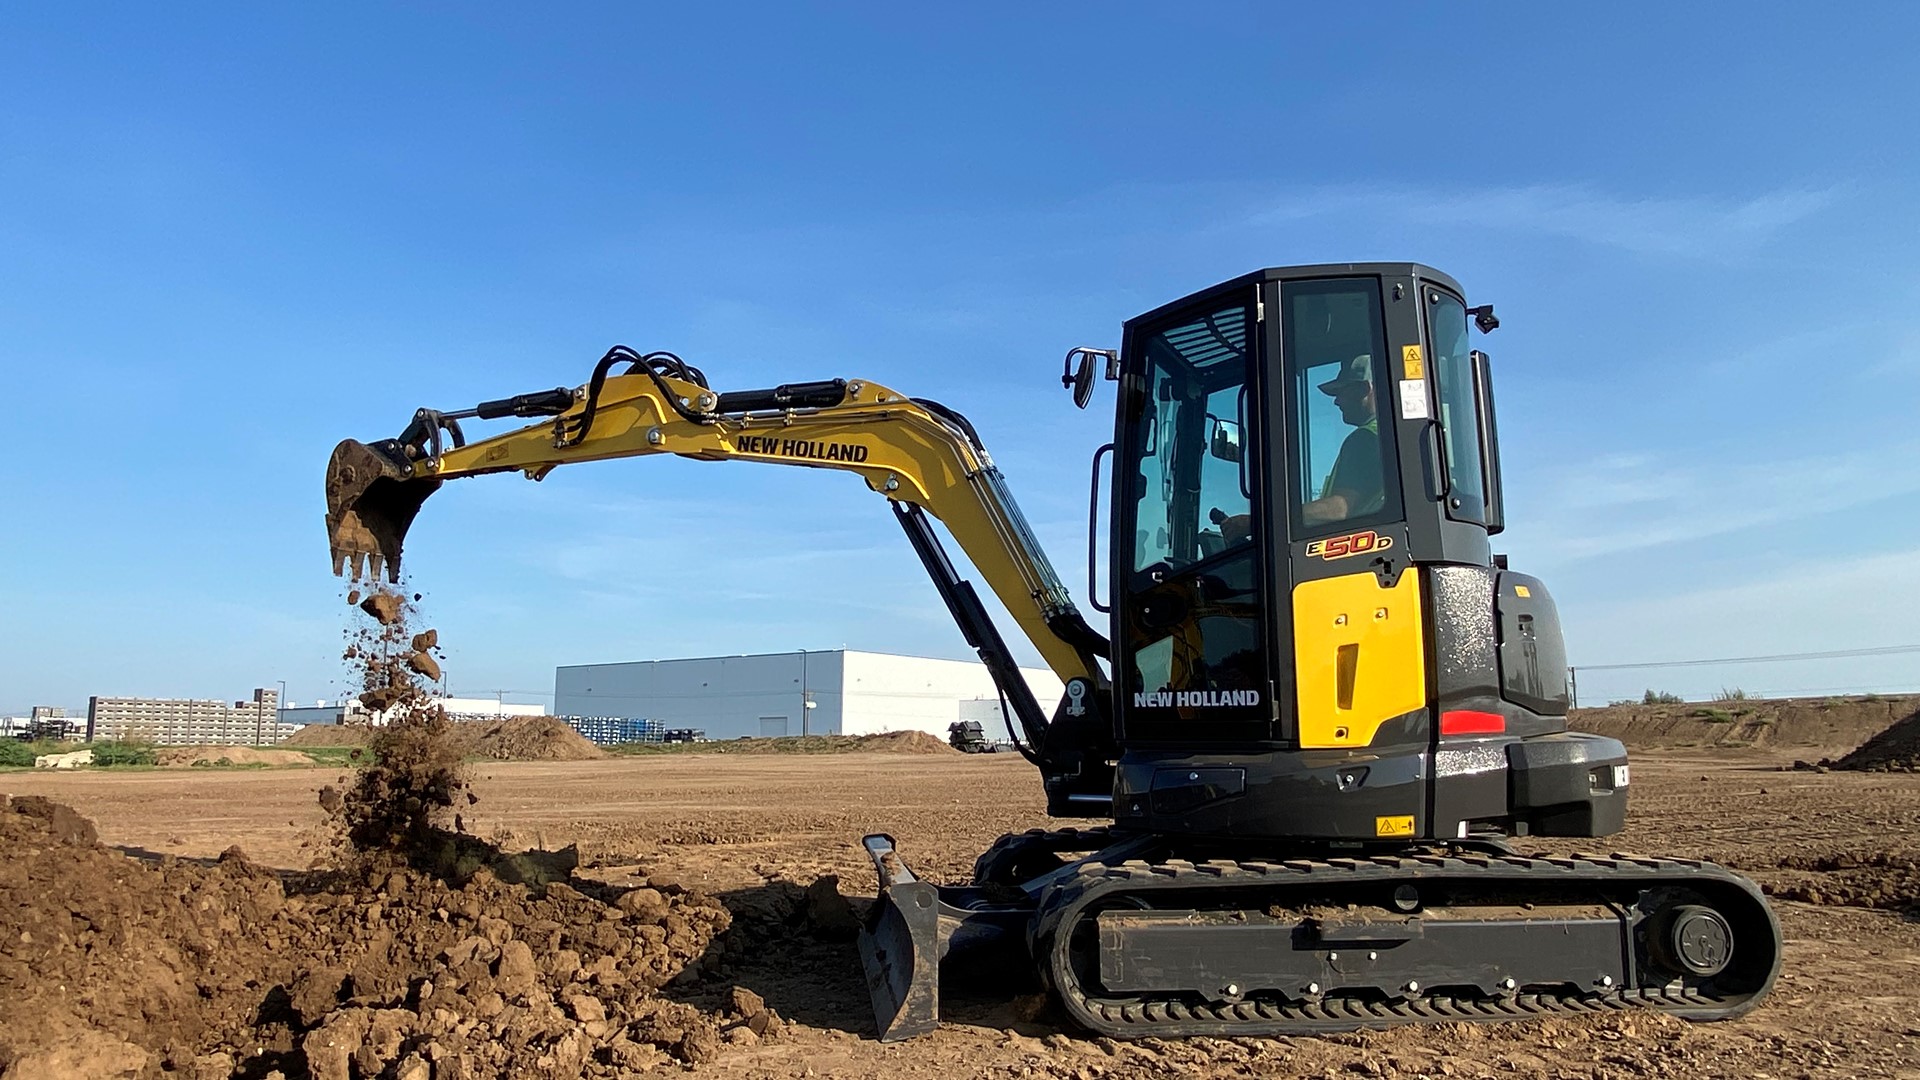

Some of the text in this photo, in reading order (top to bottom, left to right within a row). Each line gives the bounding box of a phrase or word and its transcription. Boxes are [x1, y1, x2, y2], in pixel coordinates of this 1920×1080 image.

[738, 436, 868, 462] NEW HOLLAND
[1134, 690, 1260, 707] NEW HOLLAND
